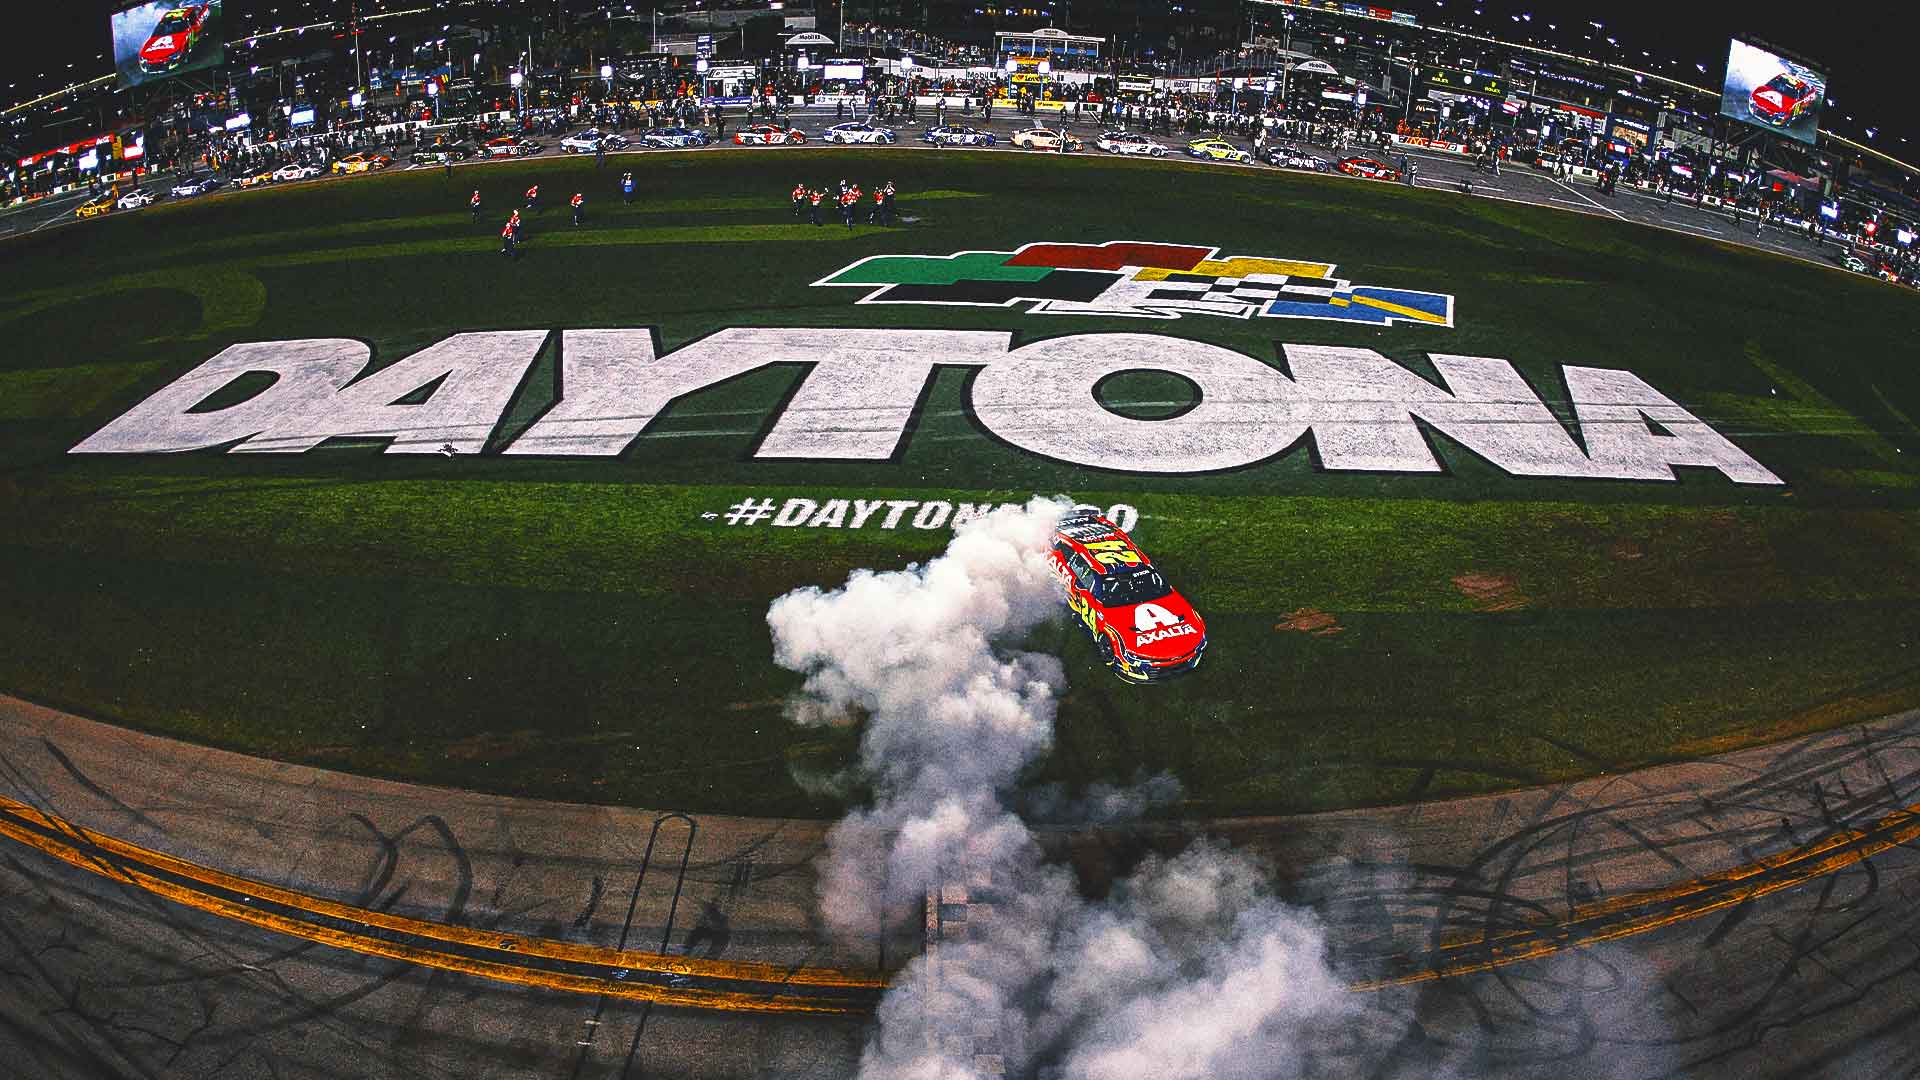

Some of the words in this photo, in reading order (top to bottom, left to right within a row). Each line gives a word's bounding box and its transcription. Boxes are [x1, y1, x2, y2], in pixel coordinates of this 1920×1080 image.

[967, 71, 988, 79] Mobil
[1484, 86, 1501, 94] ROLEX
[771, 134, 782, 142] 77
[68, 328, 1786, 485] DAYTONA
[1085, 540, 1143, 564] 24
[1136, 623, 1198, 648] AXALTA
